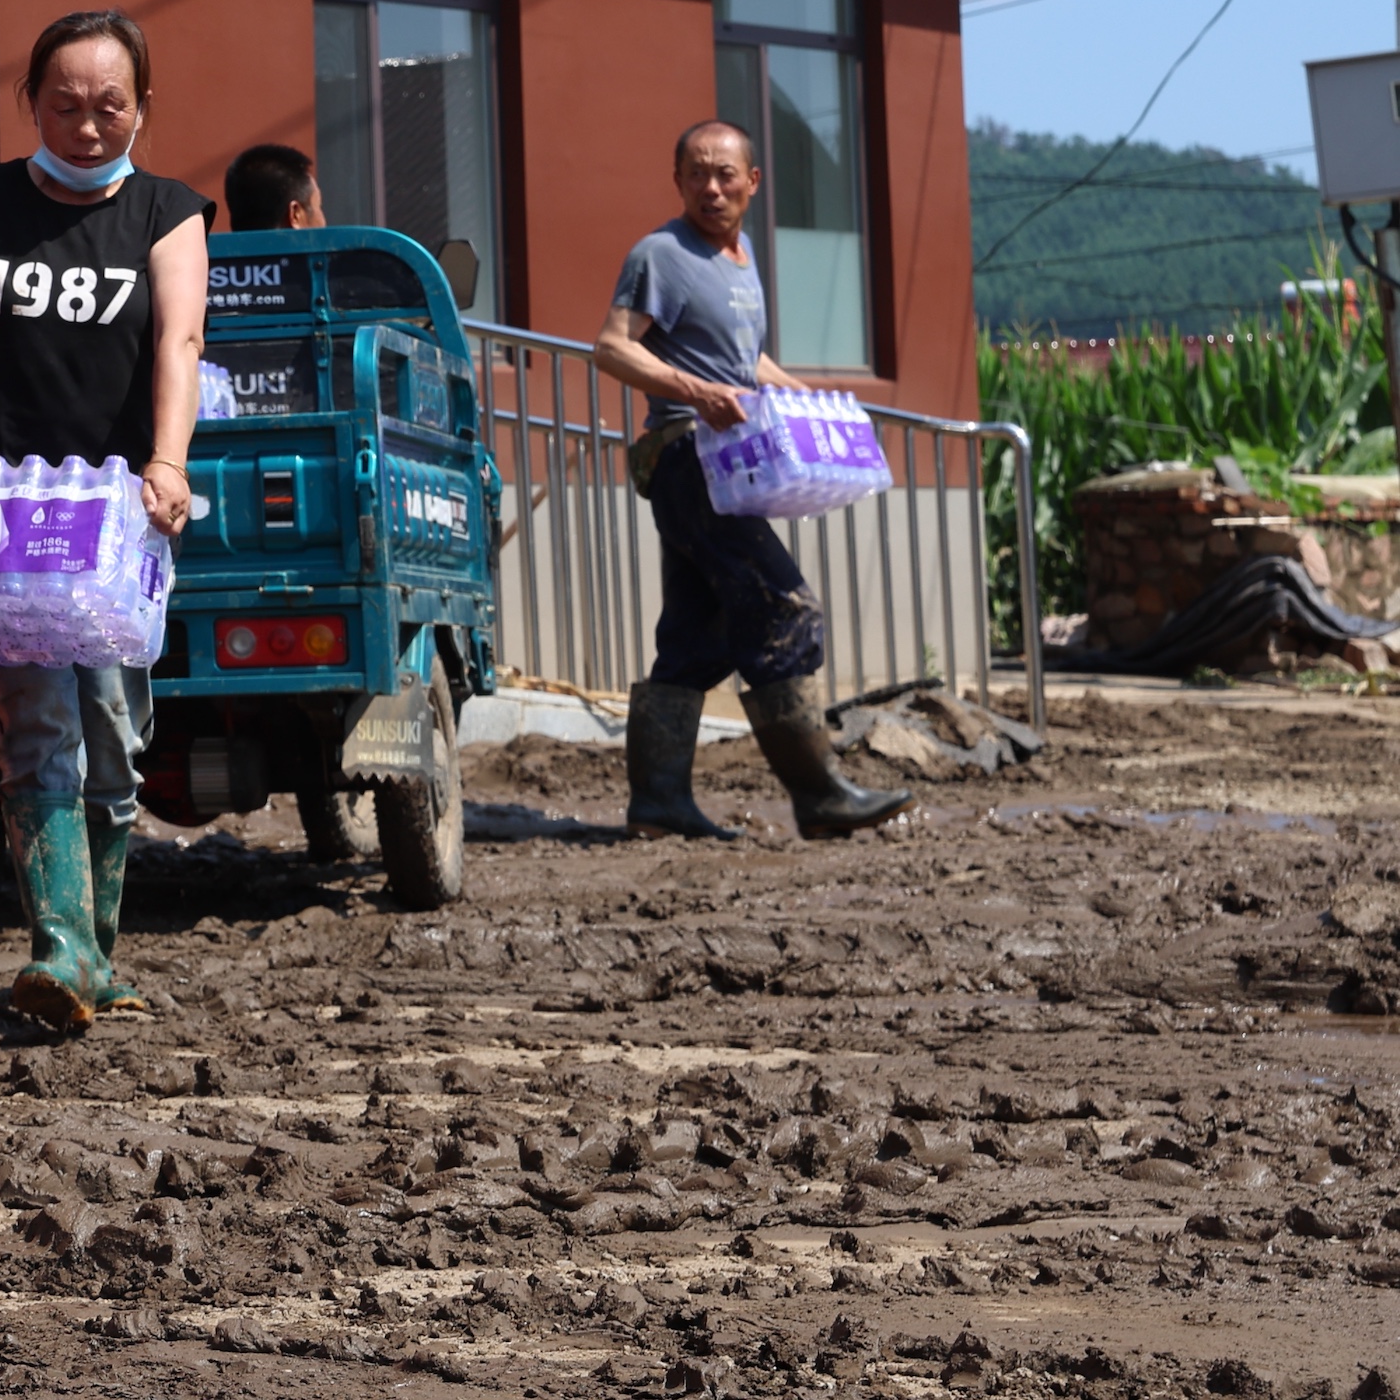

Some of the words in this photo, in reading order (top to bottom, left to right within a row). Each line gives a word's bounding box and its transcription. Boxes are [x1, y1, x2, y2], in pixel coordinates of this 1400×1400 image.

[209, 263, 282, 288] SUKI
[227, 371, 287, 396] UKI
[356, 719, 422, 744] SUNSUKI
